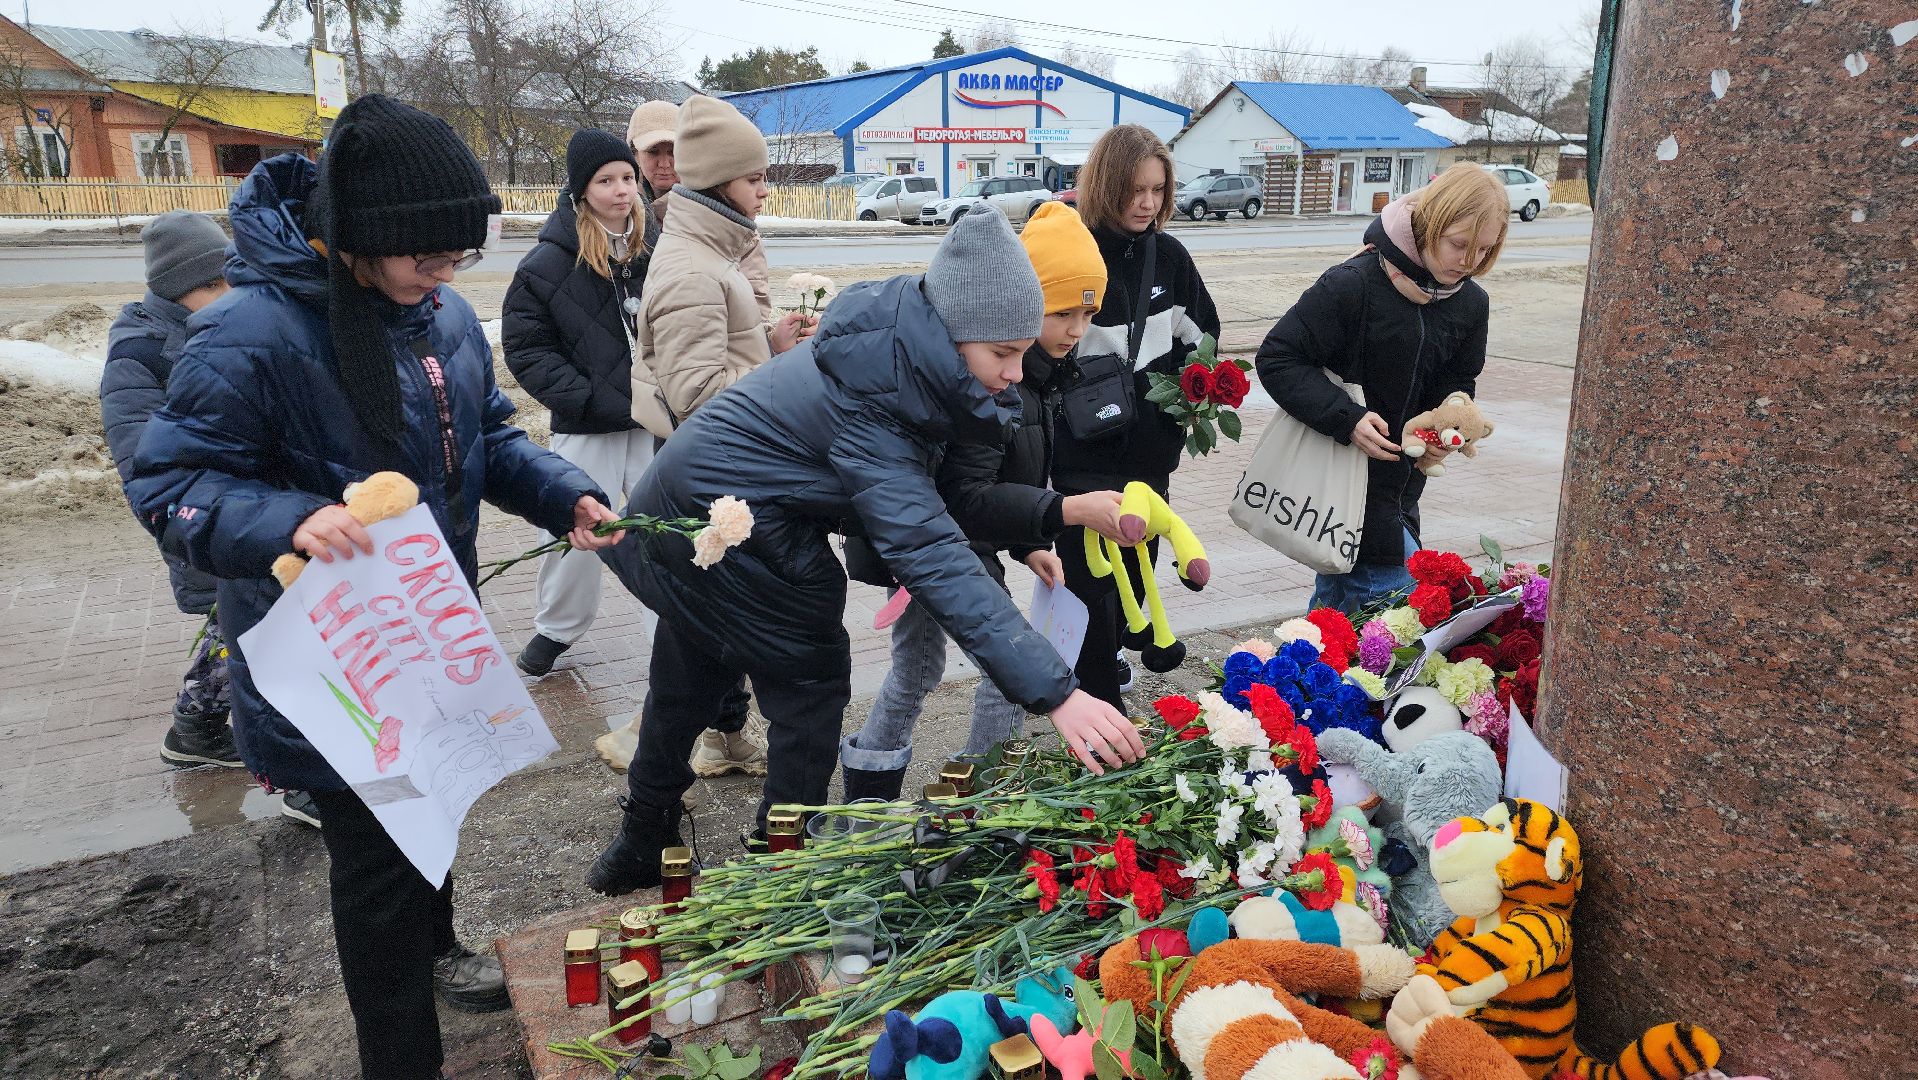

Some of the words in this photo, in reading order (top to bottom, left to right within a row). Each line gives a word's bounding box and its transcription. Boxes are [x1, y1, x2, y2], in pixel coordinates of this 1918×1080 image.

[959, 73, 1001, 90] АКВА
[1004, 74, 1064, 91] МАСТЕР
[916, 129, 1024, 142] НЕДОРОГАЯ-МЕБЕЛЬ.РФ
[1233, 471, 1361, 564] ershka
[309, 580, 400, 717] HALL
[367, 594, 436, 665] CITY
[384, 533, 501, 685] CROCUS
